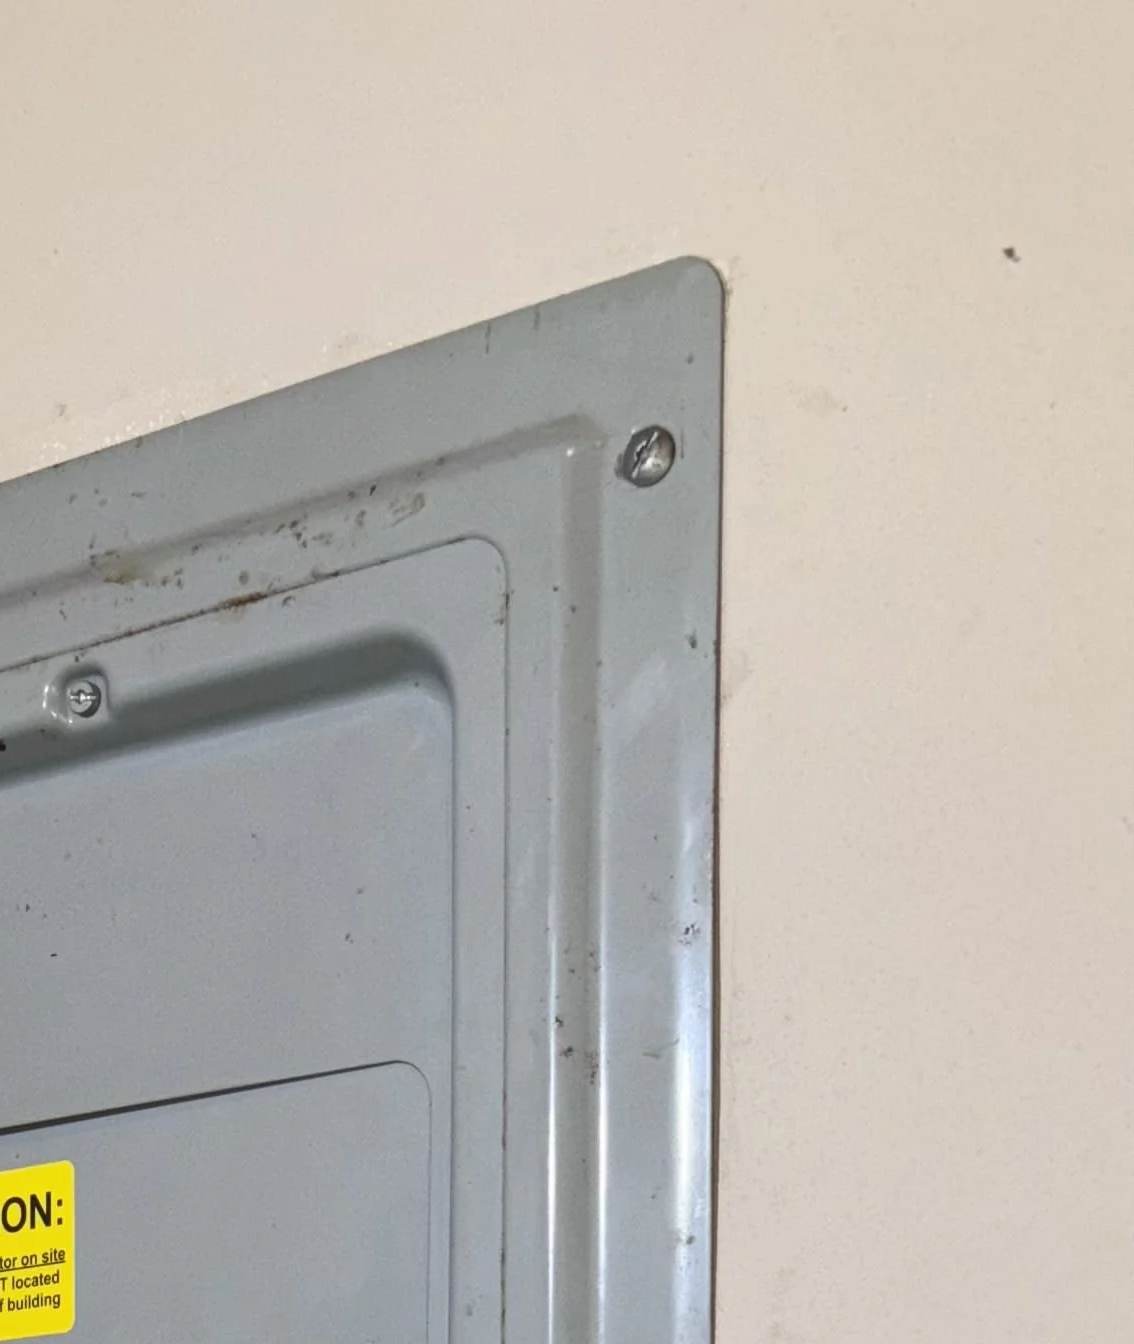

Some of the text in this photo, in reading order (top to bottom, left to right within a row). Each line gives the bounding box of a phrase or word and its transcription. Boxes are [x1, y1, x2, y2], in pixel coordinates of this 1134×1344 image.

[21, 1252, 38, 1266] on
[41, 1248, 66, 1264] site
[11, 1270, 60, 1289] located
[7, 1293, 61, 1312] building
